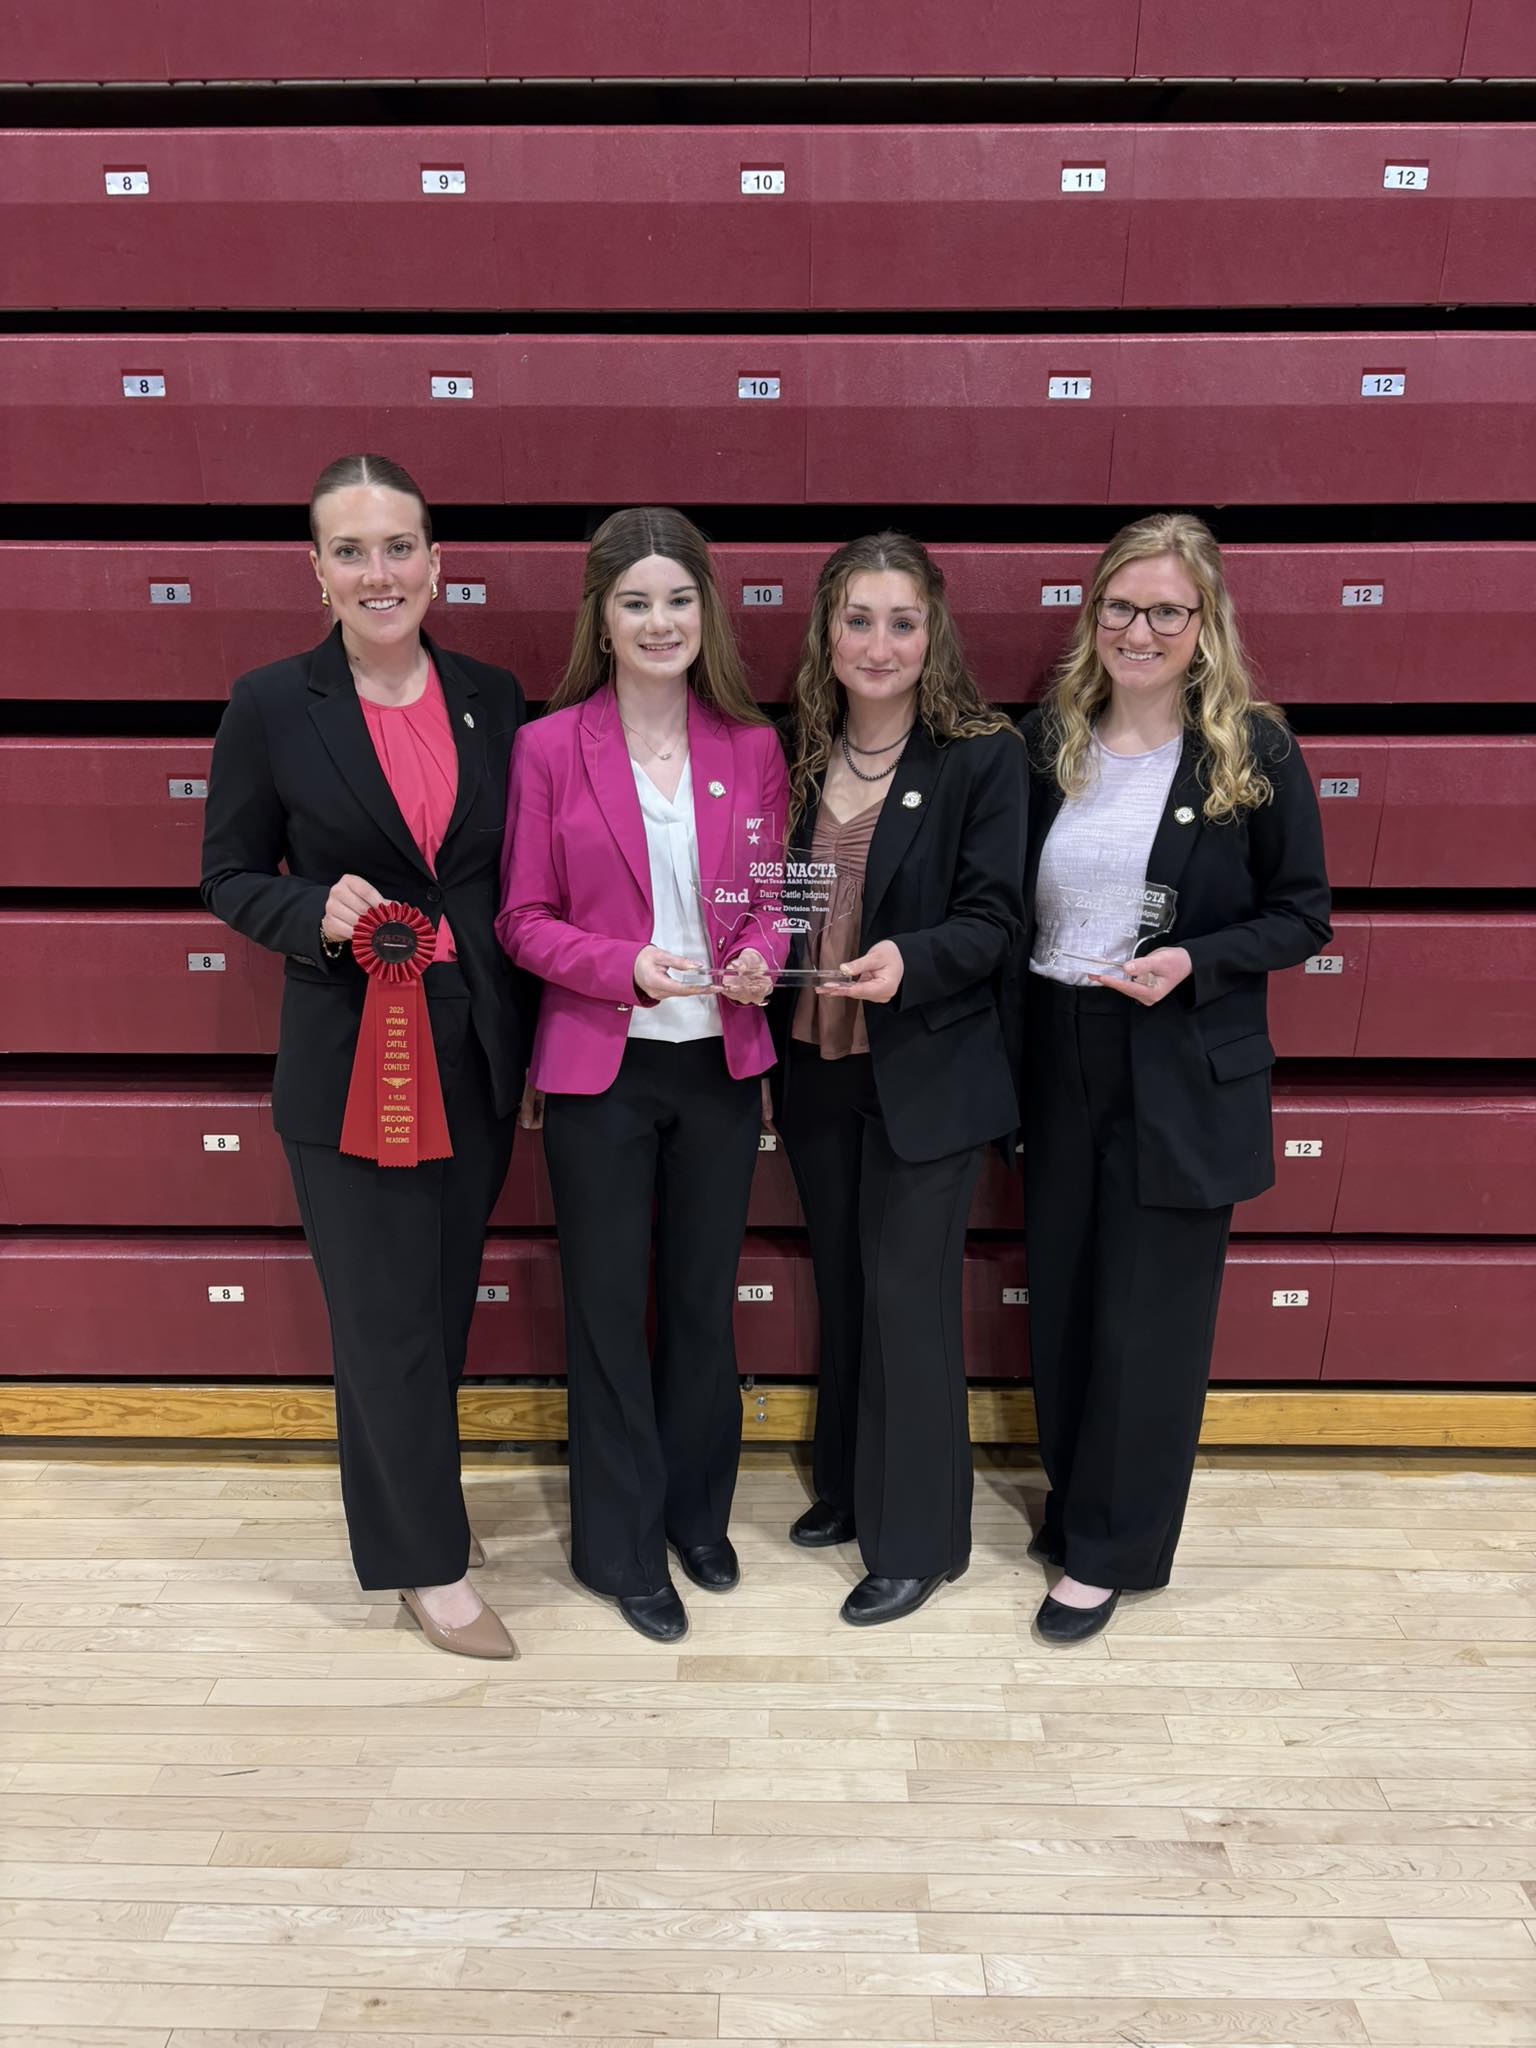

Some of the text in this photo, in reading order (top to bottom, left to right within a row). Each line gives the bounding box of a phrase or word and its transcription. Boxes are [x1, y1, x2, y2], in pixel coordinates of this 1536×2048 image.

[122, 176, 133, 191] 8
[438, 174, 449, 190] 9
[754, 174, 773, 190] 10
[1075, 172, 1092, 188] 11
[1397, 170, 1416, 186] 12
[139, 379, 150, 394] 8
[447, 380, 457, 395] 9
[750, 381, 769, 396] 10
[1062, 380, 1079, 395] 11
[1374, 378, 1393, 393] 12
[166, 587, 176, 601] 8
[461, 587, 471, 601] 9
[754, 588, 773, 603] 10
[1054, 588, 1070, 603] 11
[1354, 588, 1372, 603] 12
[184, 782, 194, 796] 8
[1331, 781, 1349, 794] 12
[746, 818, 764, 829] WT
[749, 862, 837, 878] 2025 NACTA
[715, 888, 749, 903] 2nd
[759, 890, 829, 900] Dairy Cattle Judging
[771, 917, 812, 930] NACTA
[202, 956, 212, 969] 8
[1315, 958, 1333, 971] 12
[389, 1006, 405, 1014] 2025
[388, 1029, 406, 1037] DAIRY
[386, 1040, 408, 1048] CATTLE
[384, 1052, 410, 1060] JUDGING
[383, 1063, 410, 1071] CONTEST
[380, 1115, 414, 1123] SECOND
[384, 1126, 411, 1134] PLACE
[217, 1137, 226, 1149] 8
[1295, 1142, 1312, 1155] 12
[222, 1288, 231, 1300] 8
[487, 1288, 496, 1300] 9
[747, 1287, 764, 1299] 10
[1013, 1291, 1028, 1302] 11
[1283, 1293, 1299, 1304] 12
